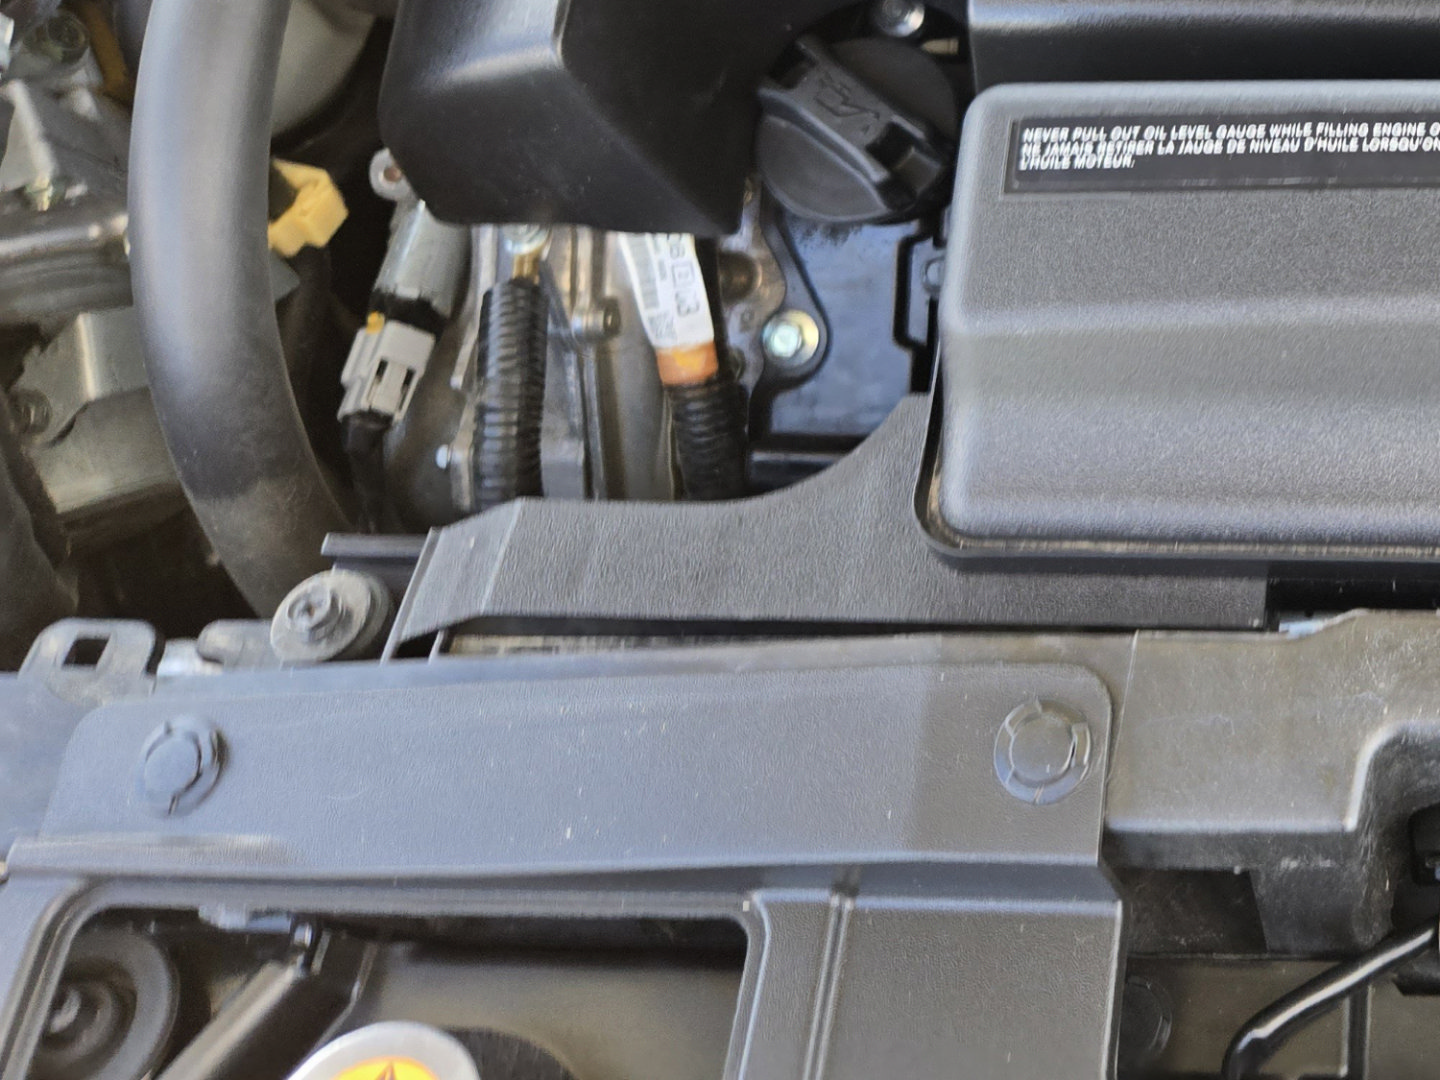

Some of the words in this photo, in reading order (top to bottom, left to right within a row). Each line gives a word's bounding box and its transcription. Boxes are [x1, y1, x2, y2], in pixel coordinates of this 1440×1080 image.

[1023, 127, 1069, 142] NEVER
[1071, 126, 1107, 142] PULL
[1110, 125, 1141, 141] OUT
[1143, 125, 1167, 140] OIL
[1170, 124, 1212, 140] LEVEL
[1215, 123, 1267, 139] GAUGE
[1269, 122, 1312, 138] WHILE
[1315, 122, 1369, 137] FILLING
[1373, 122, 1426, 137] ENGINE
[1021, 142, 1041, 156] NE
[1043, 141, 1094, 156] JAMAIS
[1097, 140, 1154, 155] RETIRER
[1157, 139, 1175, 155] LA
[1177, 139, 1224, 154] JAUGE
[1226, 139, 1246, 154] DE
[1249, 138, 1300, 153] NIVEAU
[1303, 137, 1359, 152] D'HUILE
